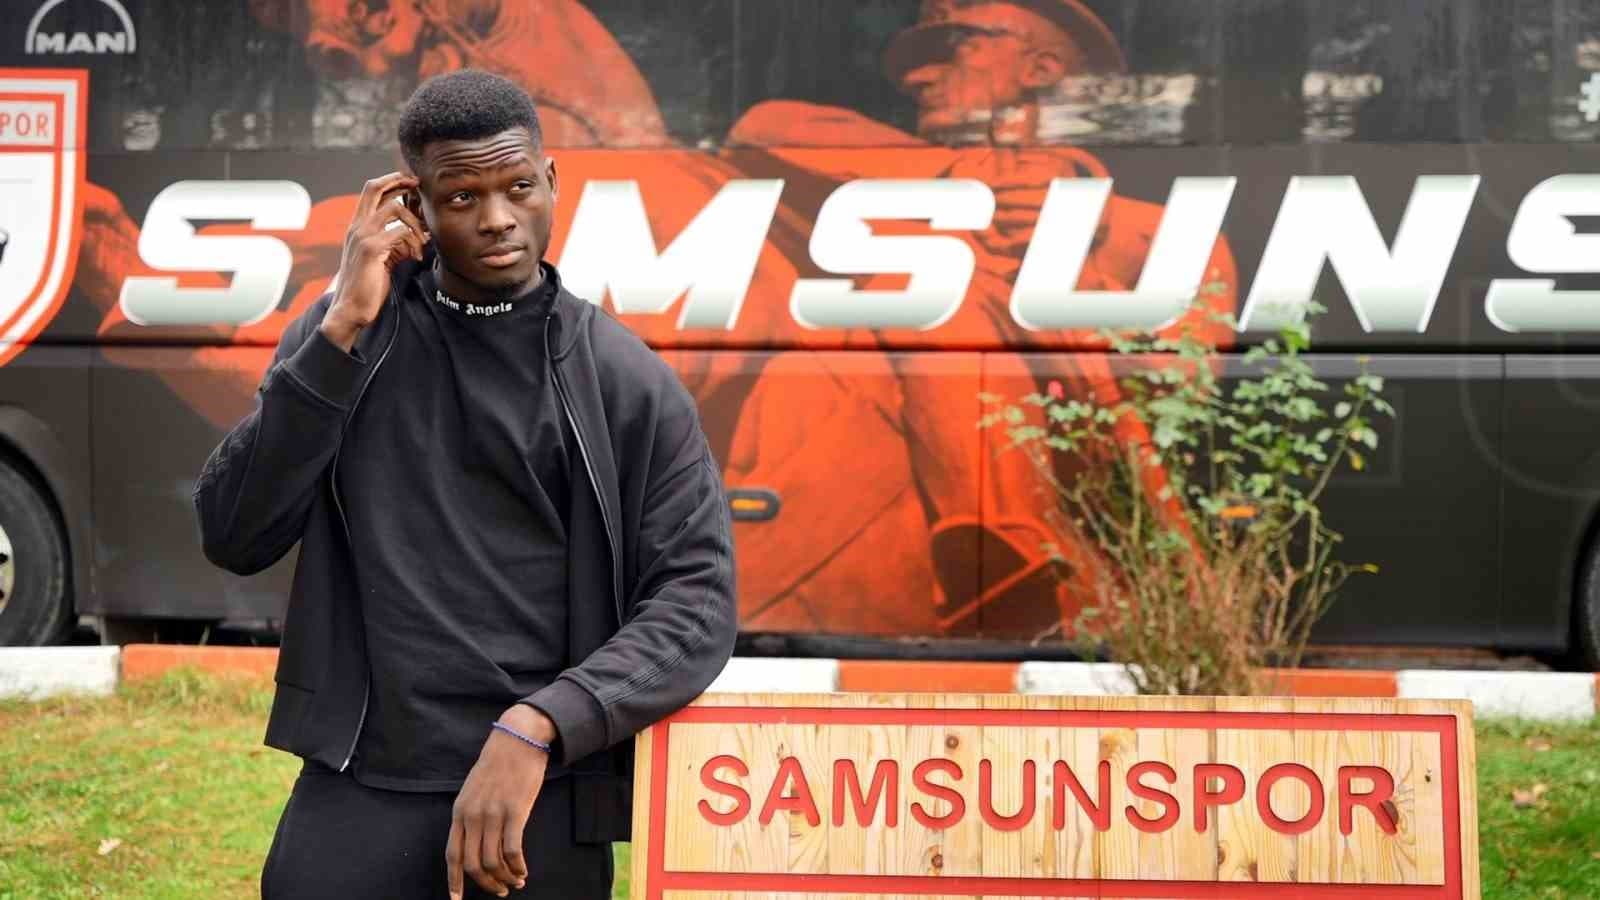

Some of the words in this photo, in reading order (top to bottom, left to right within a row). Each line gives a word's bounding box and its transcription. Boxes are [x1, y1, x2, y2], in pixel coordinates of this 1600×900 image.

[35, 32, 126, 54] MAN
[118, 174, 1600, 333] SMSUNS
[465, 302, 513, 316] Angels
[697, 754, 1399, 836] SAMSUNSPOR
